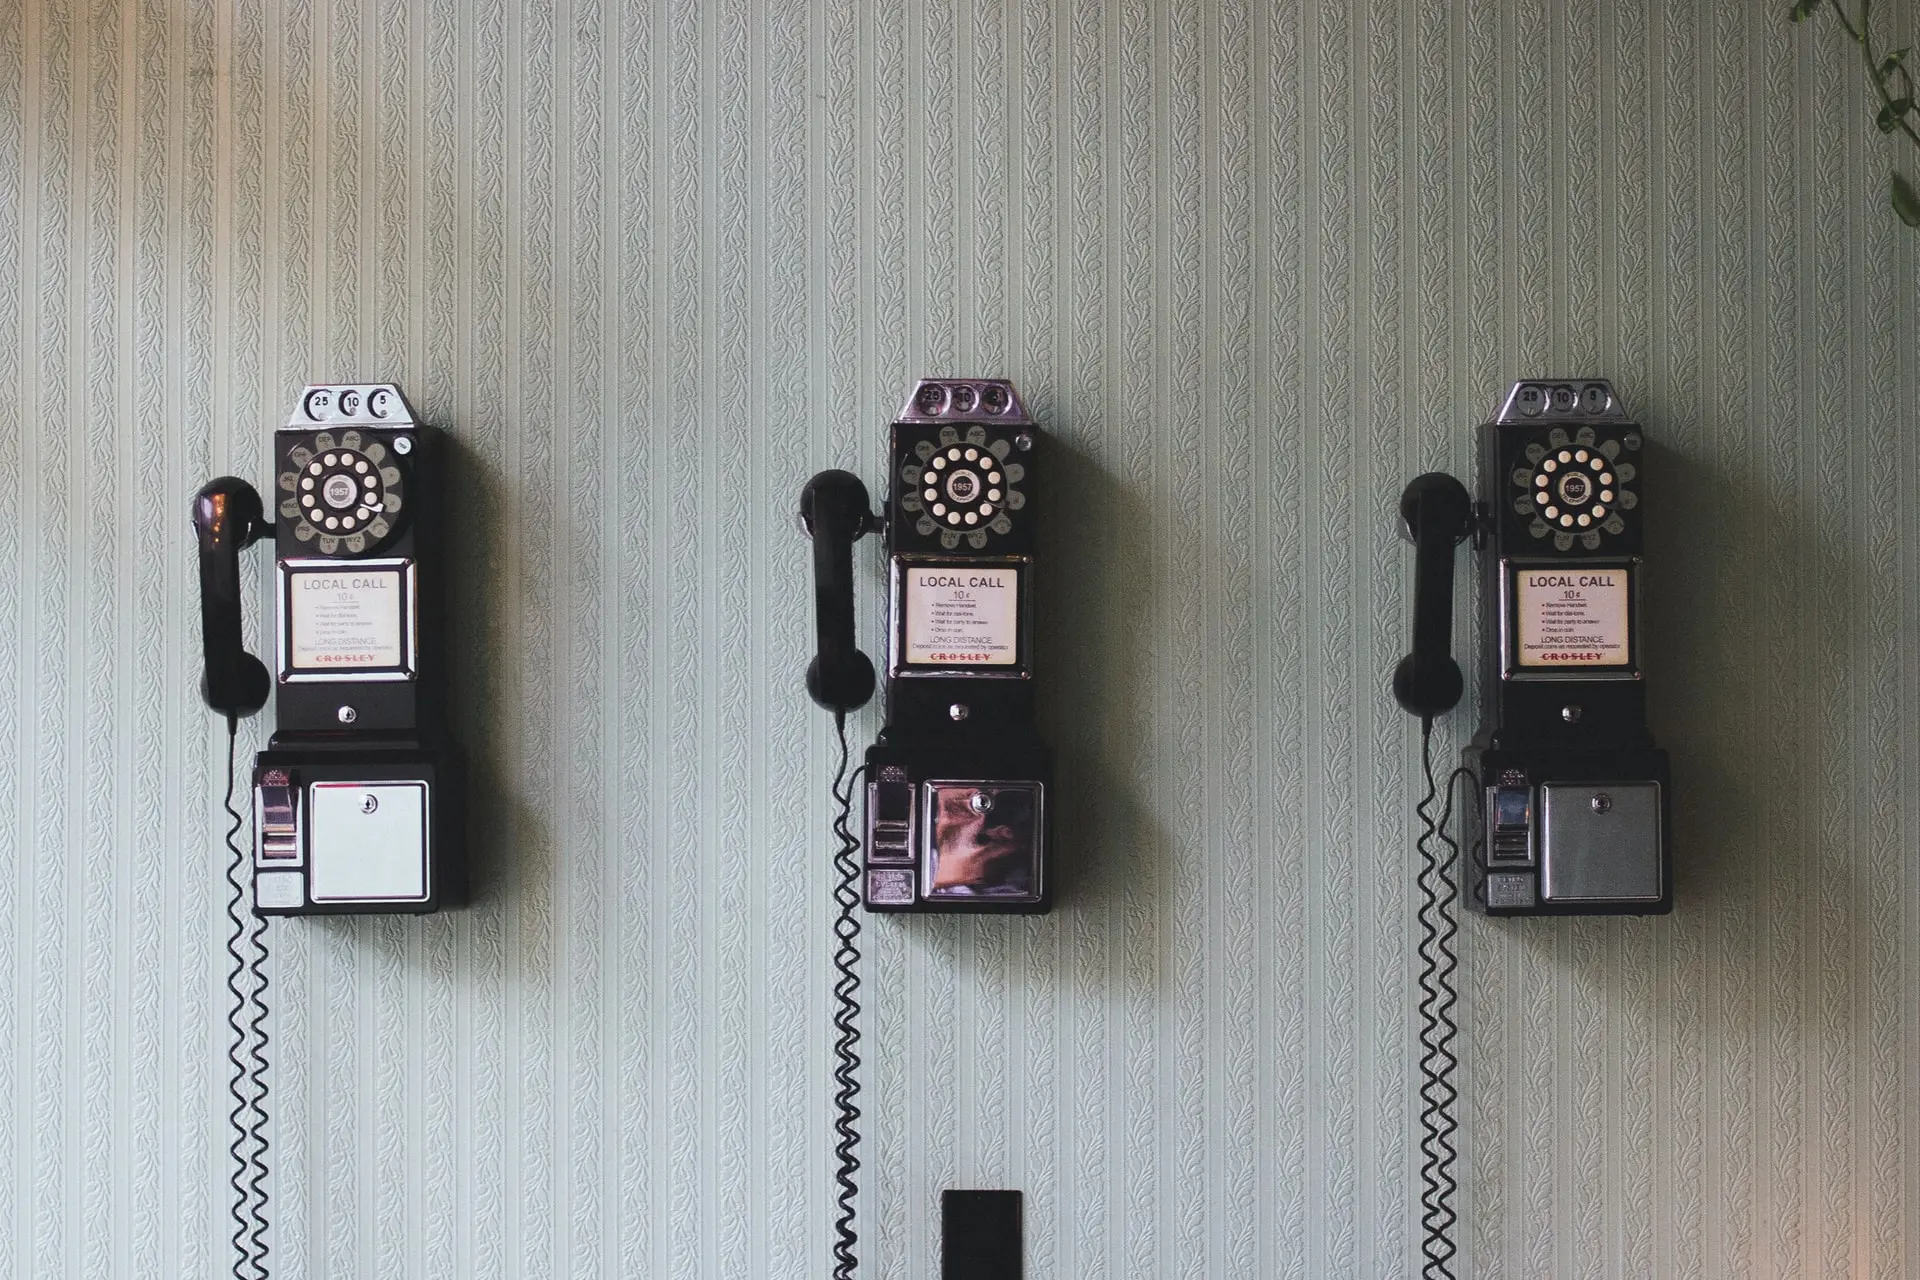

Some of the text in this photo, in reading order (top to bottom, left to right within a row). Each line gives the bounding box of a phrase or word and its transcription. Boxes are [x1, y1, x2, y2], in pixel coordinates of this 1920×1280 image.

[1524, 390, 1596, 402] 25 10 5
[315, 395, 386, 407] 25 10 5
[953, 483, 972, 491] 1957
[1565, 484, 1585, 493] 1957
[330, 488, 348, 496] 1957
[1561, 493, 1591, 504] TELEPHONE
[303, 578, 388, 590] LOCAL CALL
[920, 576, 1005, 588] LOCAL CALL
[1529, 576, 1615, 587] LOCAL CALL
[953, 636, 992, 644] DISTANCE
[315, 654, 376, 663] CROSLEY
[930, 653, 991, 661] CROSLEY
[1541, 652, 1603, 661] CROSLEY
